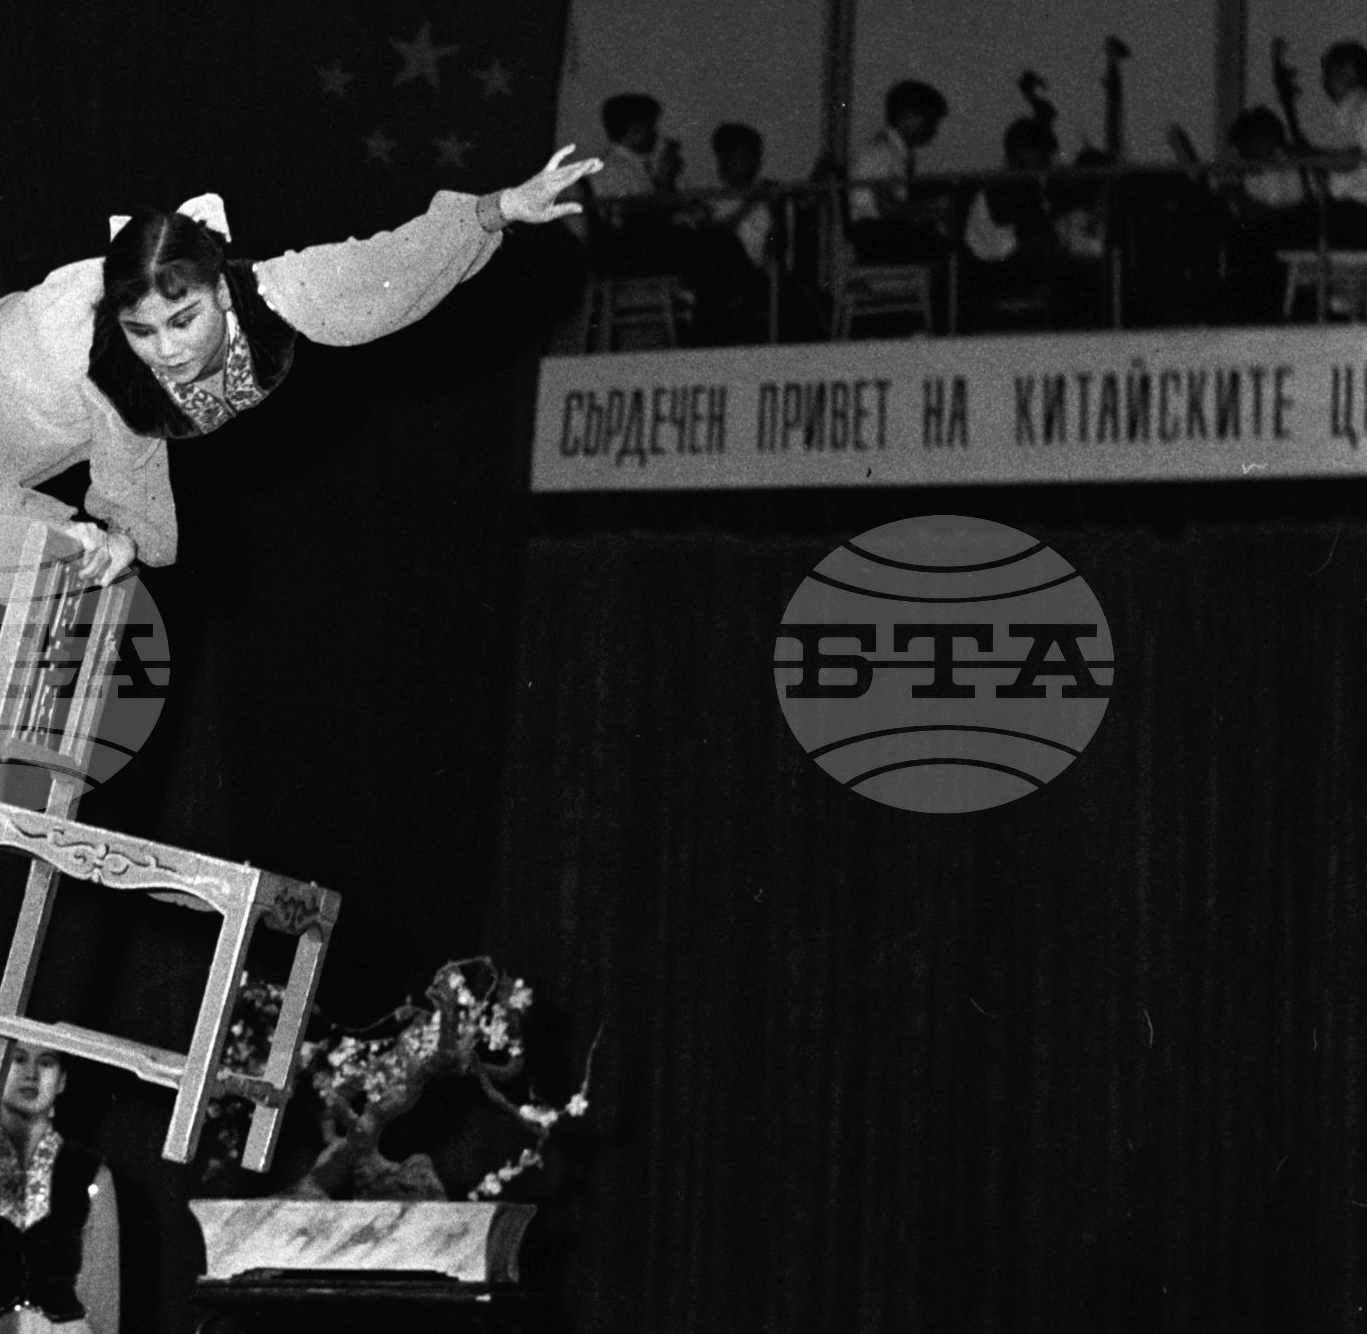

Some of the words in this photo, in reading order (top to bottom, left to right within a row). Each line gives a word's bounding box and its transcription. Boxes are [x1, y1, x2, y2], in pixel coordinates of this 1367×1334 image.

[756, 377, 890, 453] ПРИВЕТ
[922, 374, 969, 450] НА
[1014, 356, 1295, 447] КИТАЙСКИТЕ
[1332, 364, 1367, 450] Ц
